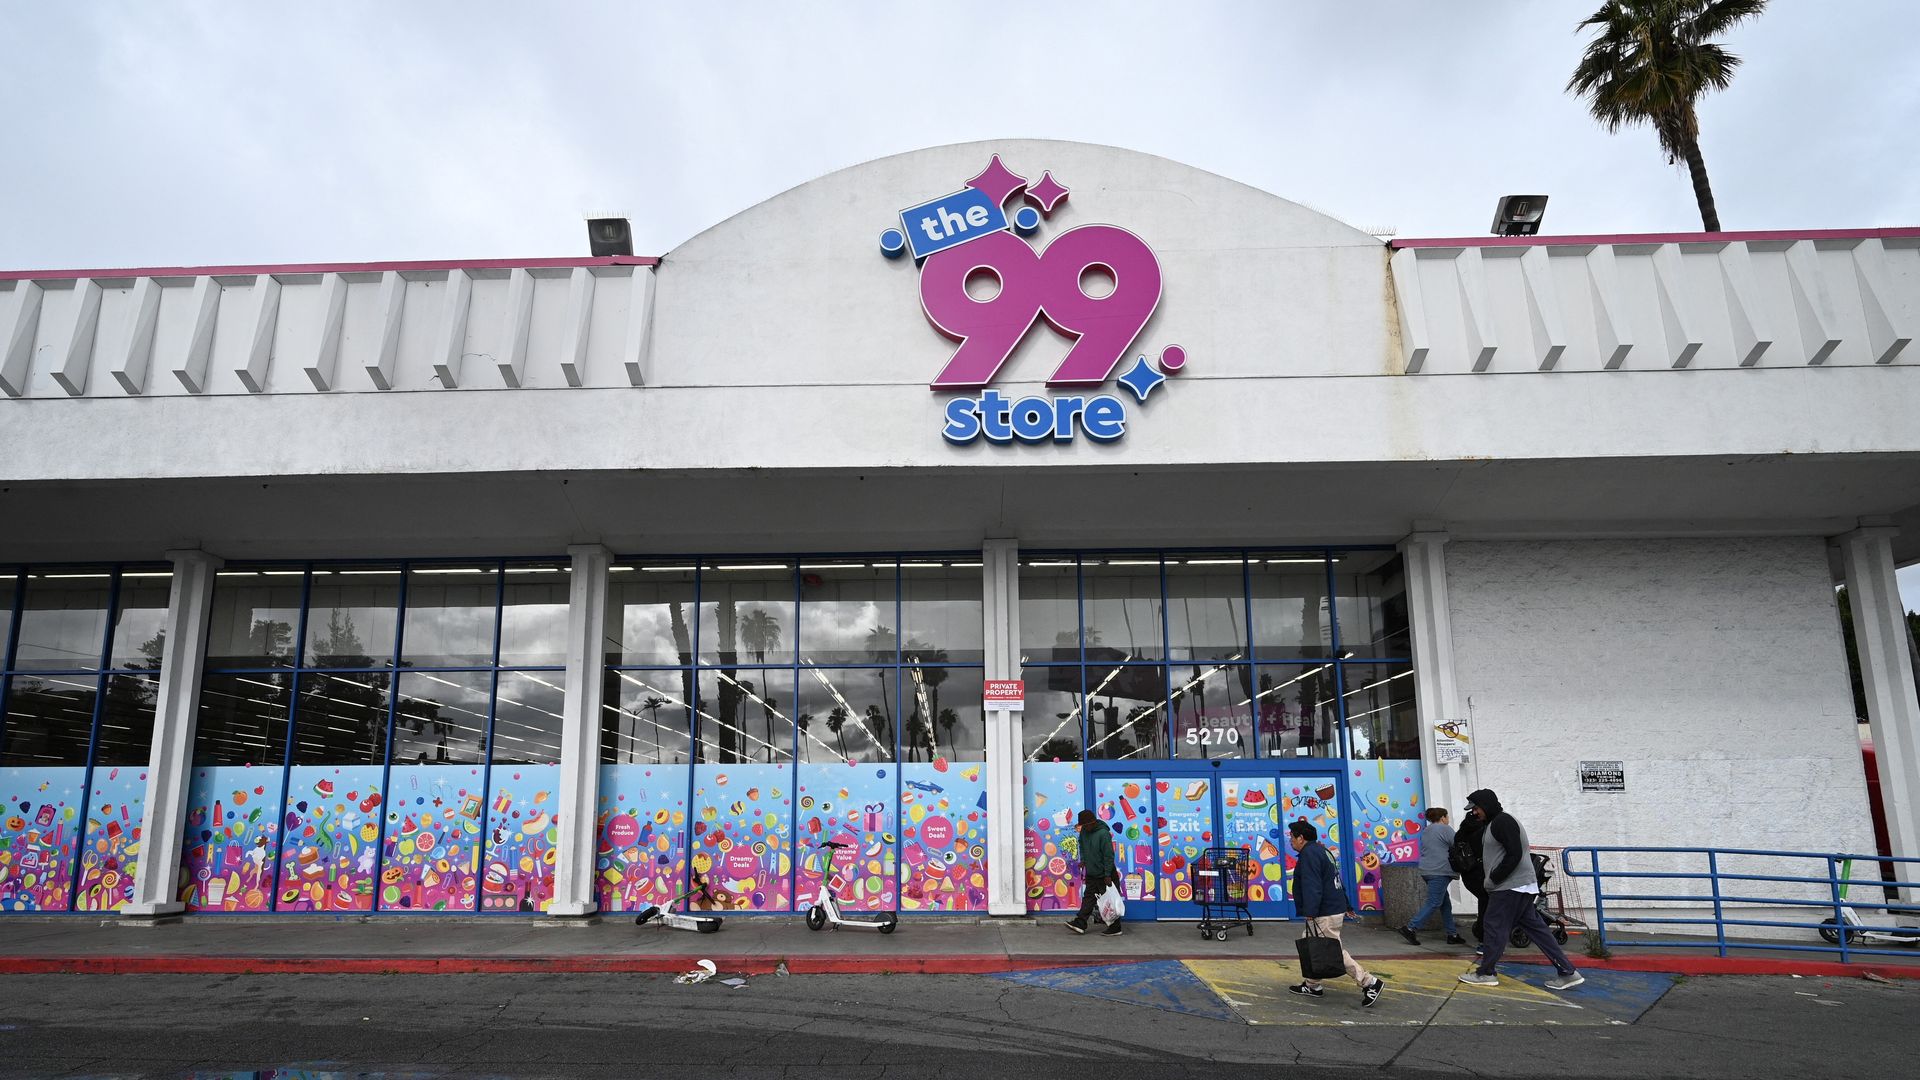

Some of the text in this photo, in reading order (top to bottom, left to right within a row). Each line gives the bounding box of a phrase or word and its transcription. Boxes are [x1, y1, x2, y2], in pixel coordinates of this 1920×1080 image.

[920, 204, 990, 242] the
[919, 223, 1164, 390] 99
[943, 389, 1127, 444] store
[1200, 712, 1260, 728] Beaut
[1185, 727, 1239, 745] 5270
[1169, 817, 1201, 832] Exit
[1235, 816, 1268, 832] Exit
[730, 855, 753, 863] Dreamy
[1395, 846, 1413, 859] 99
